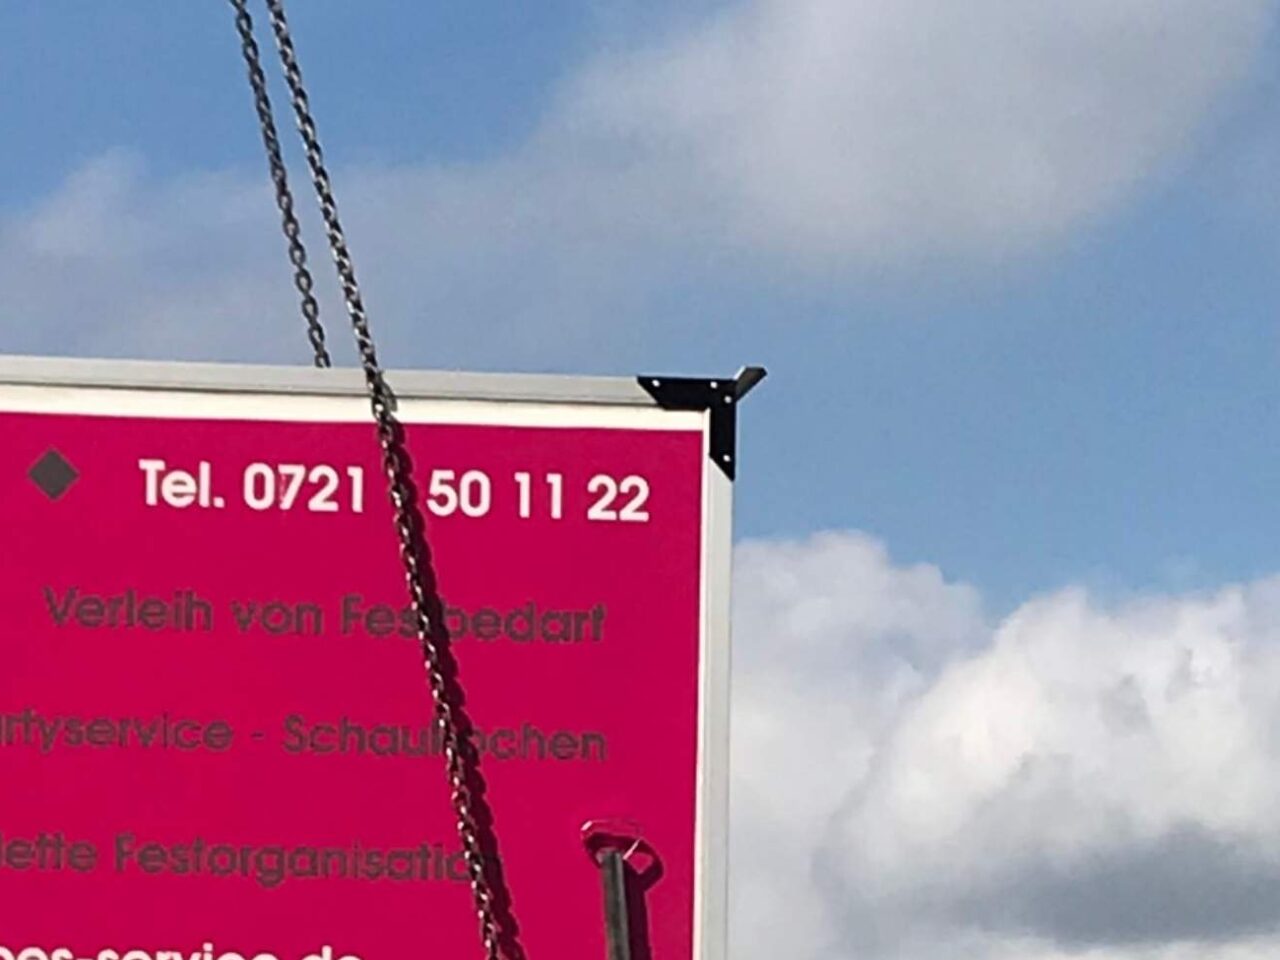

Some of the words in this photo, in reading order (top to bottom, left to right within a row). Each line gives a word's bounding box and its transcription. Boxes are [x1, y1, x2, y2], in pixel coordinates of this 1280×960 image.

[138, 458, 226, 509] Tel.
[242, 462, 365, 513] 0721
[425, 469, 491, 518] 50
[512, 470, 563, 520] 11
[586, 473, 650, 522] 22
[40, 584, 214, 633] Verleih
[229, 600, 324, 636] von
[340, 592, 609, 643] Fesbedarf
[114, 832, 506, 888] Festorganisatio
